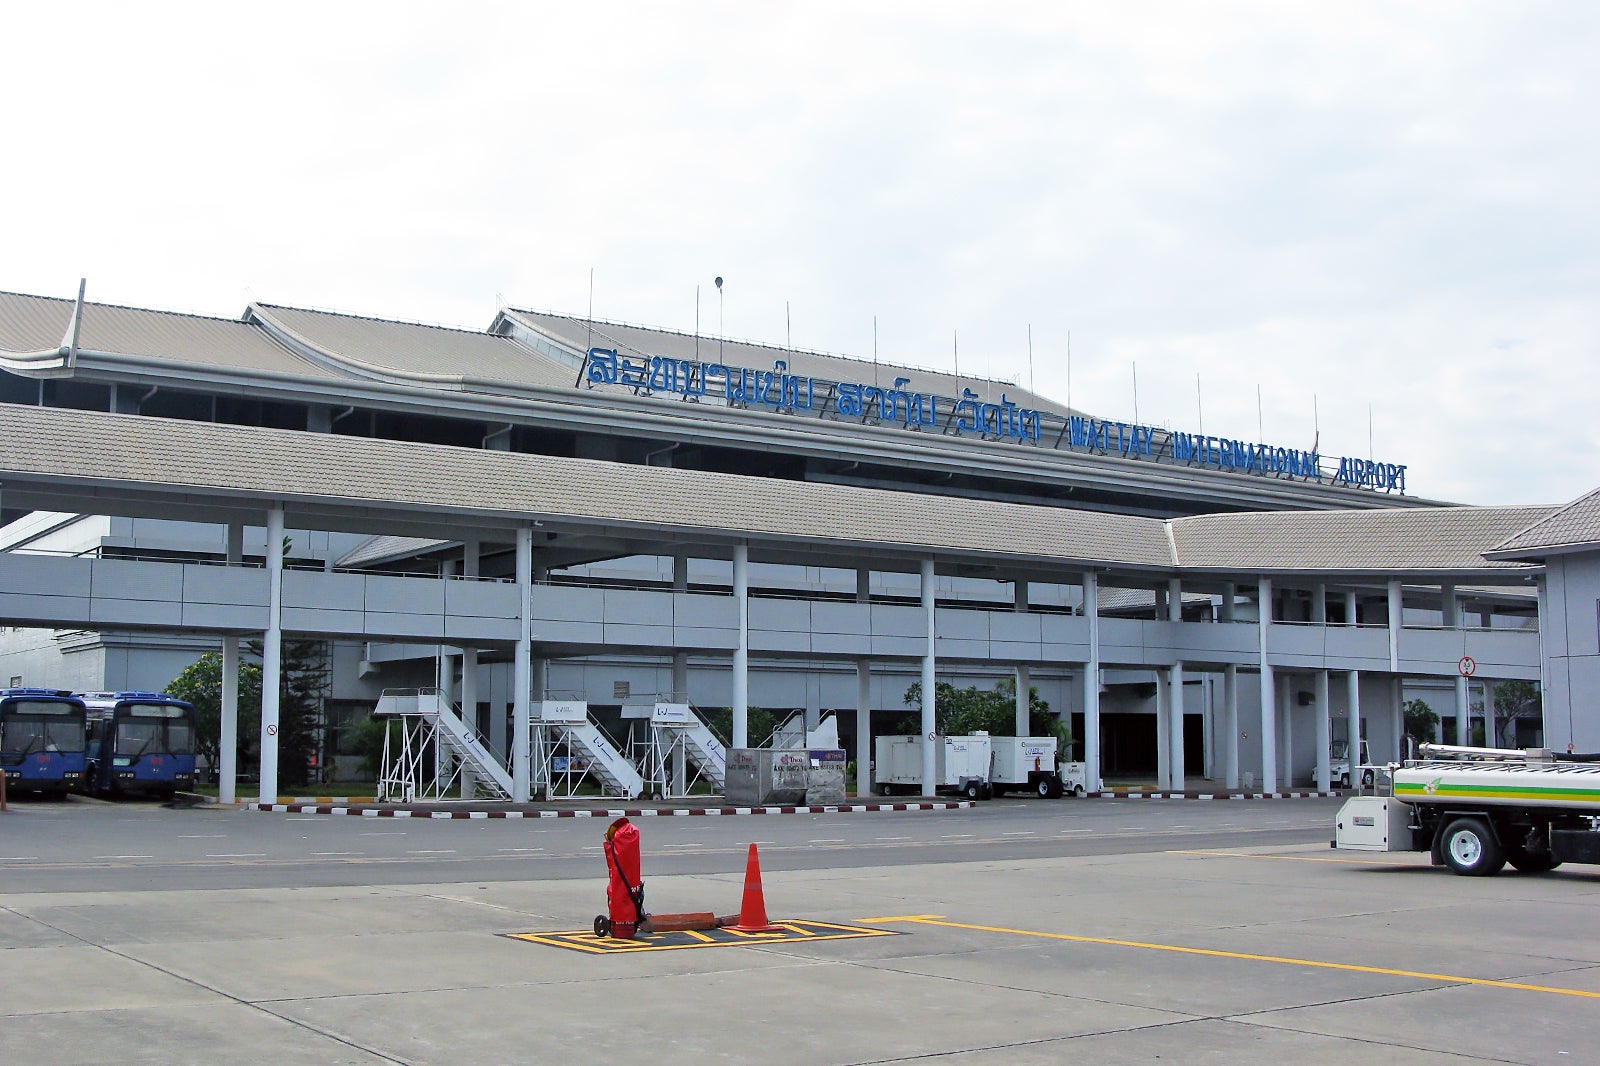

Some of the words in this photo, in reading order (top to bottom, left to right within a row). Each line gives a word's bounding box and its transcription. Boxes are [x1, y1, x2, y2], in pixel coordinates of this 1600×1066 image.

[1069, 415, 1155, 456] WATTAY
[1173, 431, 1322, 479] INTERNATIONAL
[1337, 456, 1408, 490] AIRPORT
